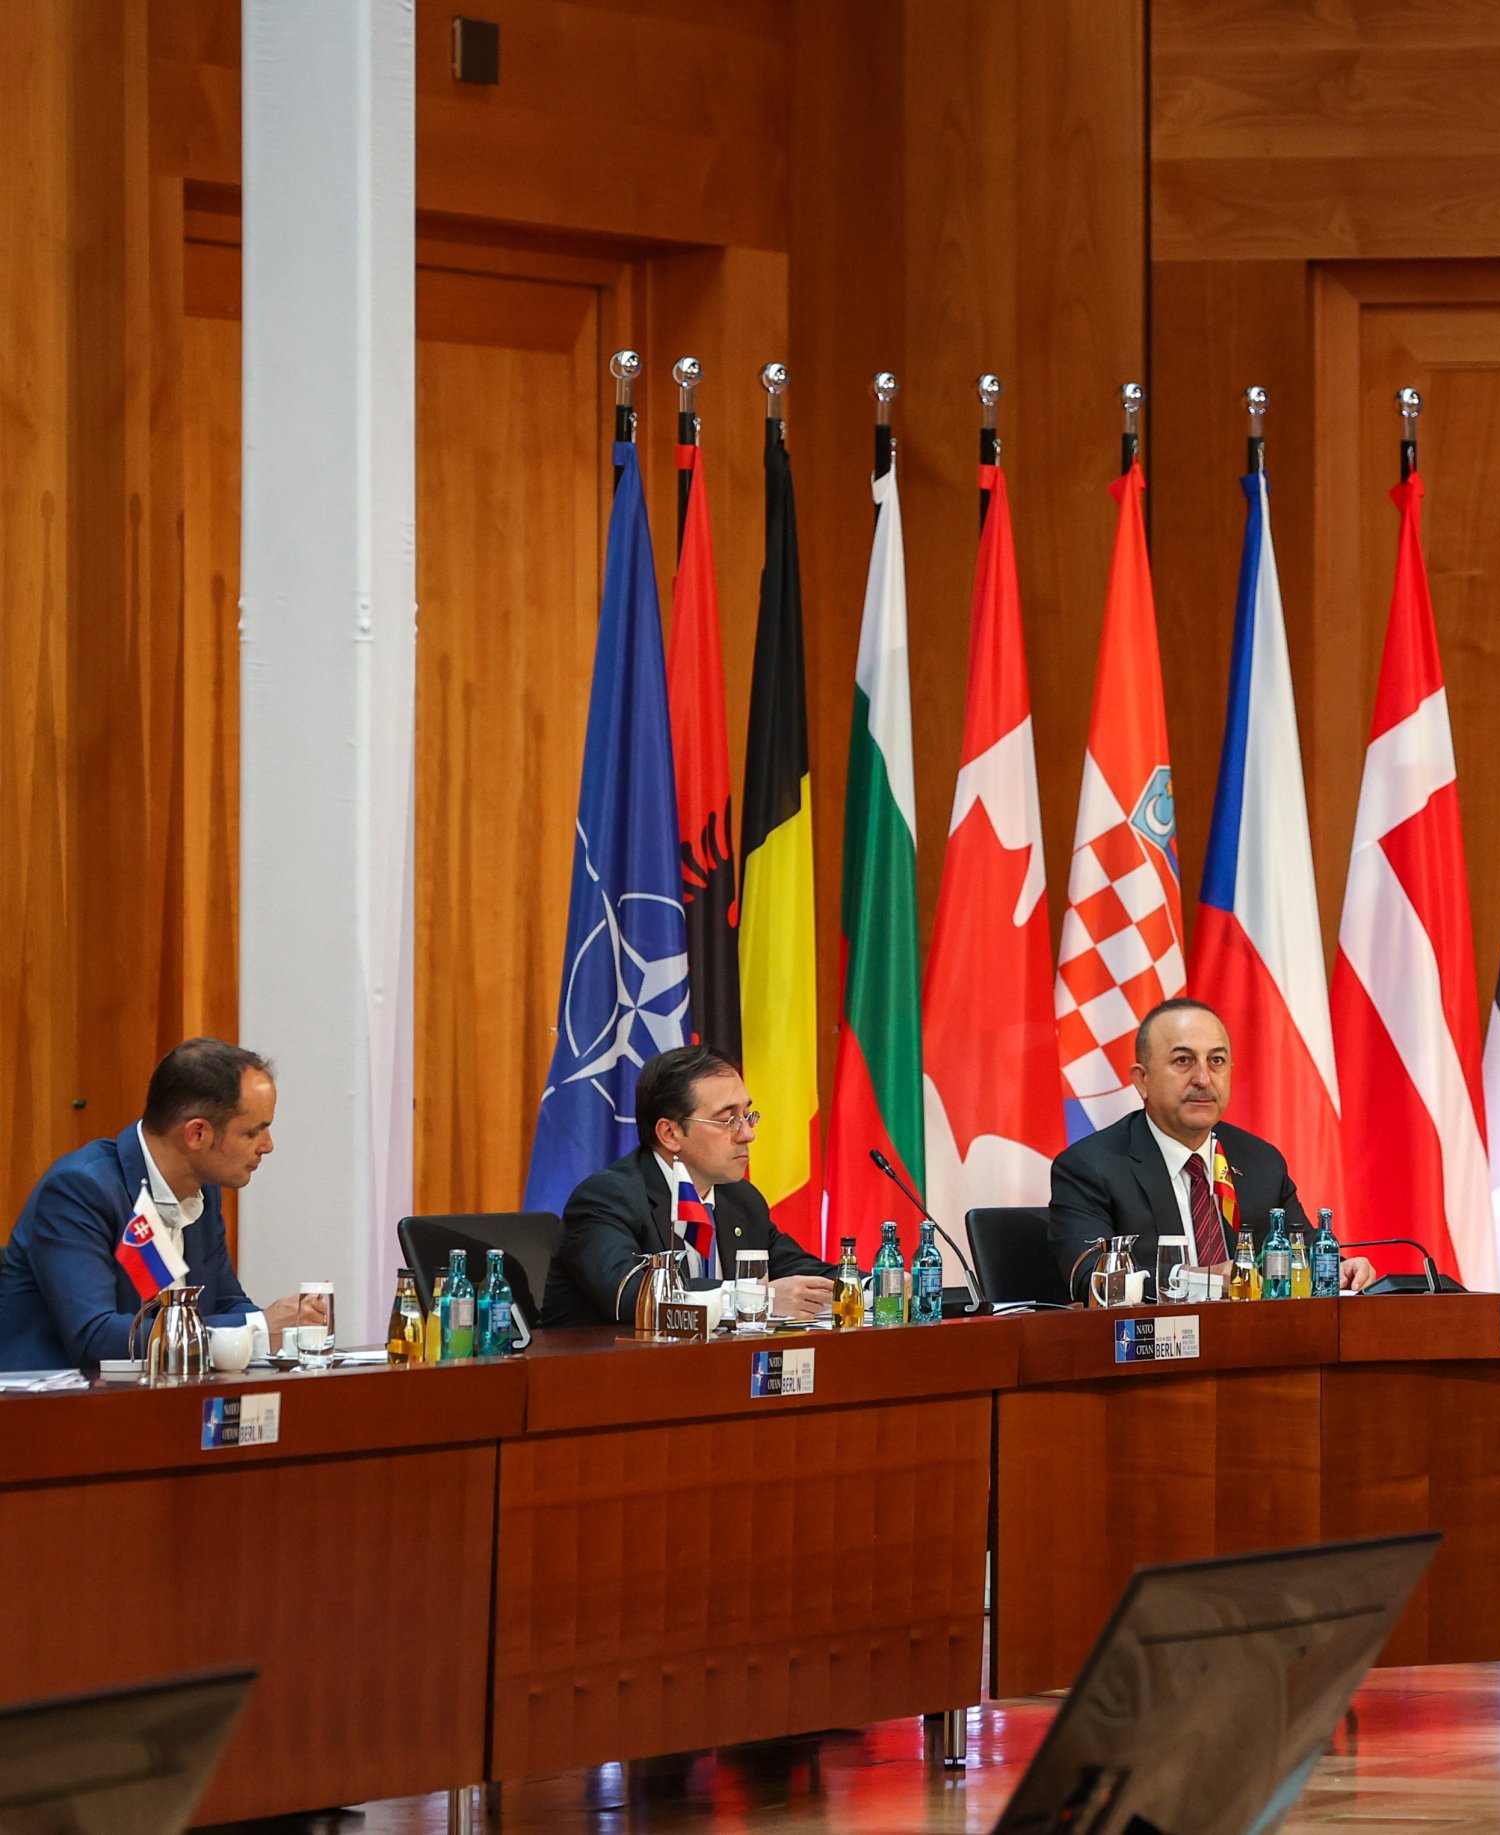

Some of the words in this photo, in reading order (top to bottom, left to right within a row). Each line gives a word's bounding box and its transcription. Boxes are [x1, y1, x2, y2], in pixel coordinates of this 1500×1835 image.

[666, 1308, 699, 1331] SLOVENIE
[1136, 1324, 1154, 1335] NATO
[1136, 1344, 1154, 1356] OTAN
[1155, 1342, 1182, 1357] BERLIN
